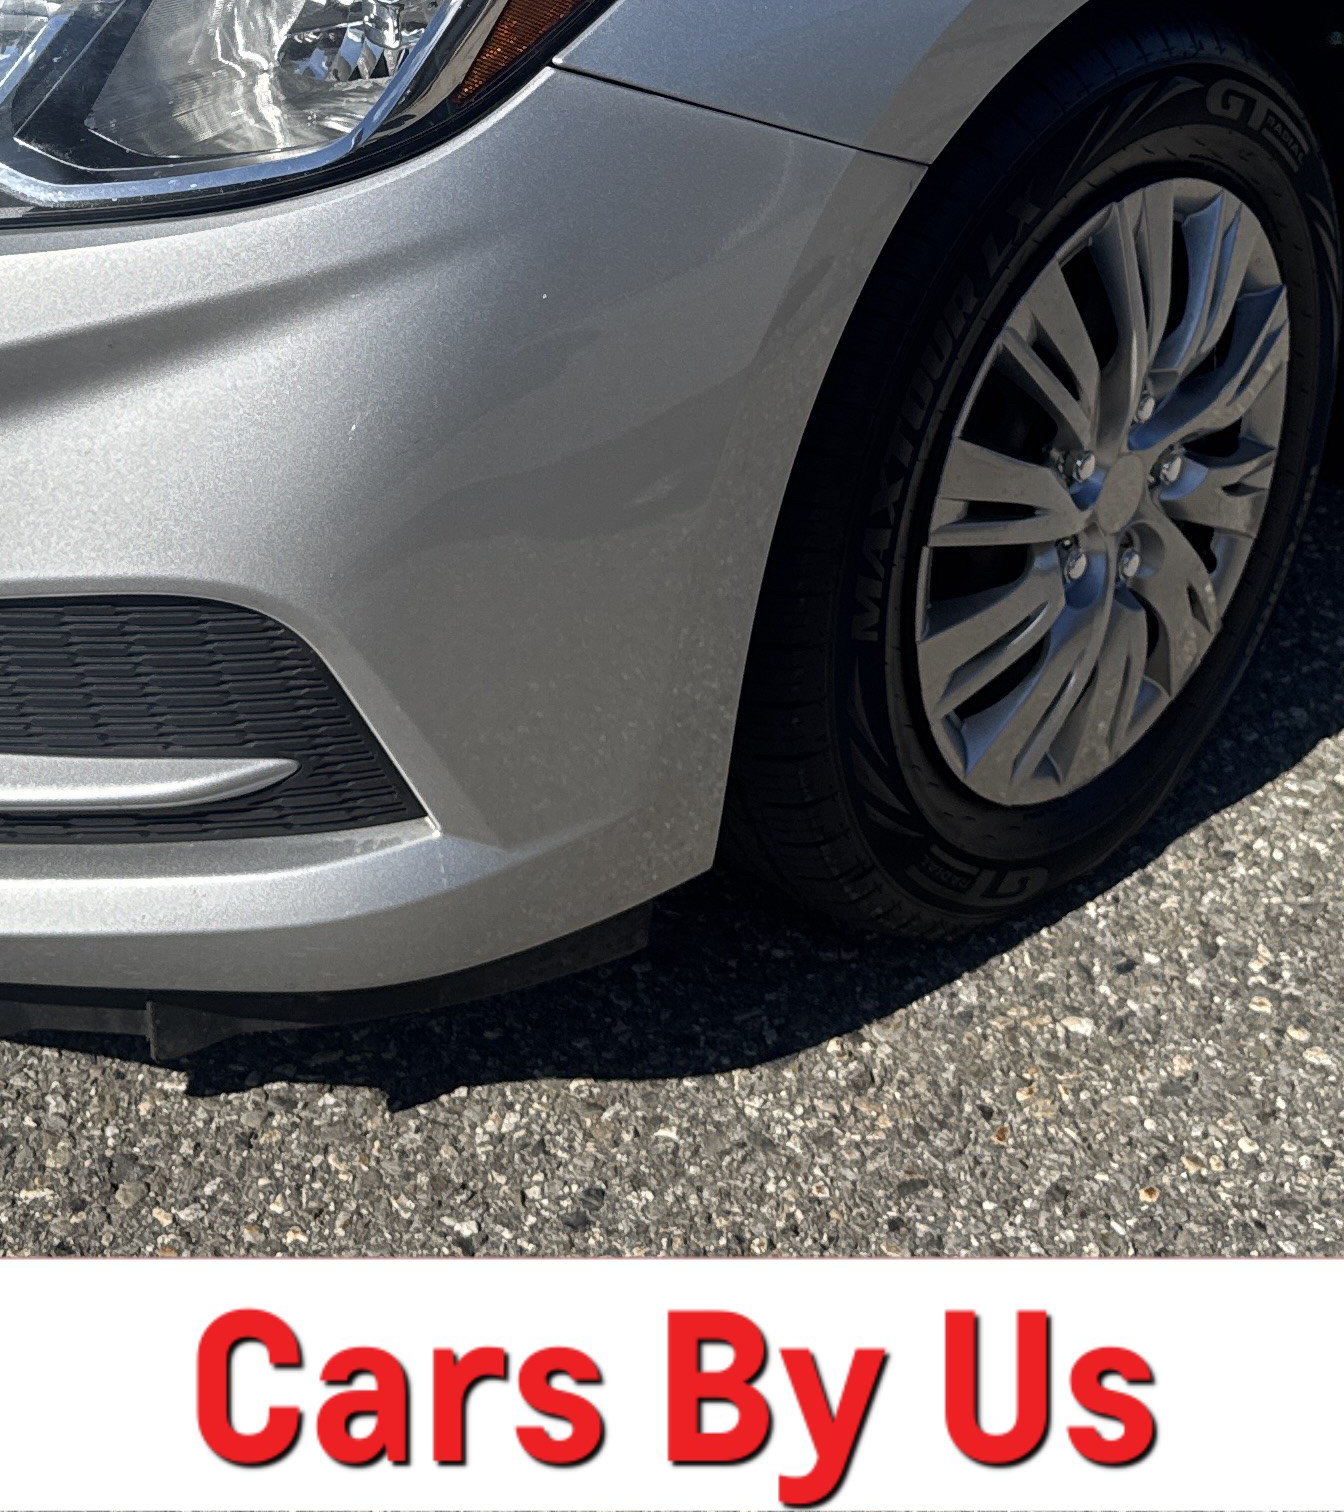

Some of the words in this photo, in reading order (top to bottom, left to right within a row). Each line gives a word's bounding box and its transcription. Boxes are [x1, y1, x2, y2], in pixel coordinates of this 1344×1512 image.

[1205, 78, 1296, 140] GT
[1265, 114, 1305, 167] RADIAL
[849, 273, 980, 642] MAXTOUR
